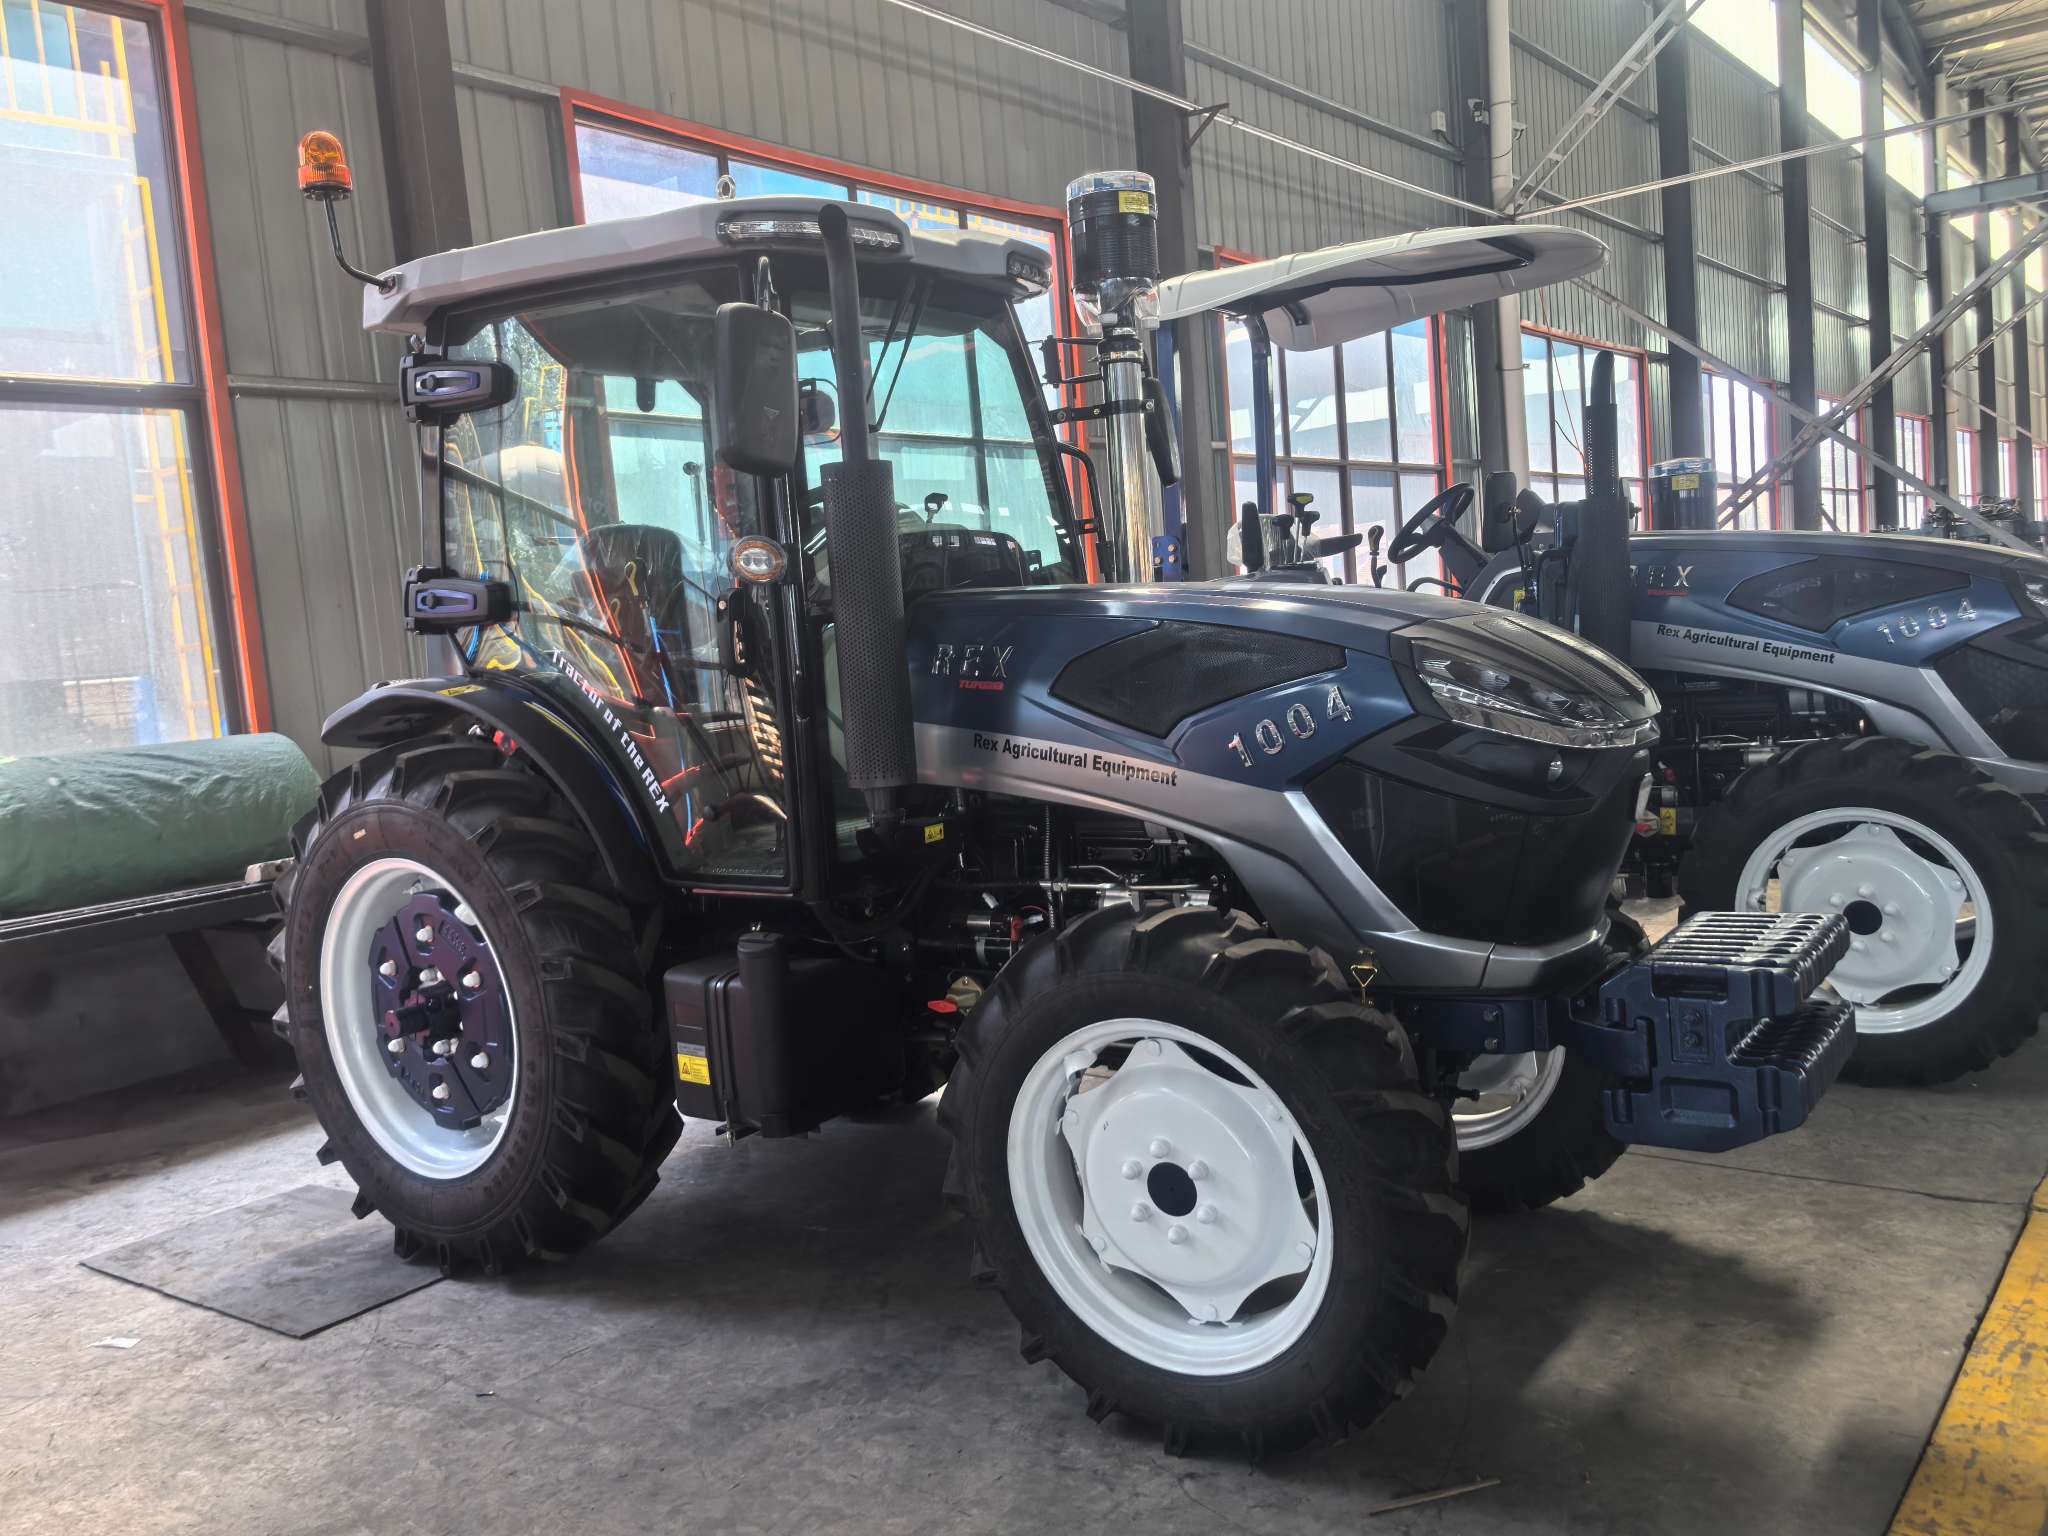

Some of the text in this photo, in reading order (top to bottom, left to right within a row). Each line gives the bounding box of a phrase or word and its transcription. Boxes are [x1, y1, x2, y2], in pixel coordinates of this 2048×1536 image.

[1656, 624, 1836, 664] Rex Agricultural Equipment
[1876, 598, 1977, 644] 1004
[931, 644, 1015, 678] REX
[552, 646, 670, 813] Tractor of the REX
[1228, 684, 1353, 768] 1004
[973, 733, 1178, 787] Rex Agricultural Equipment
